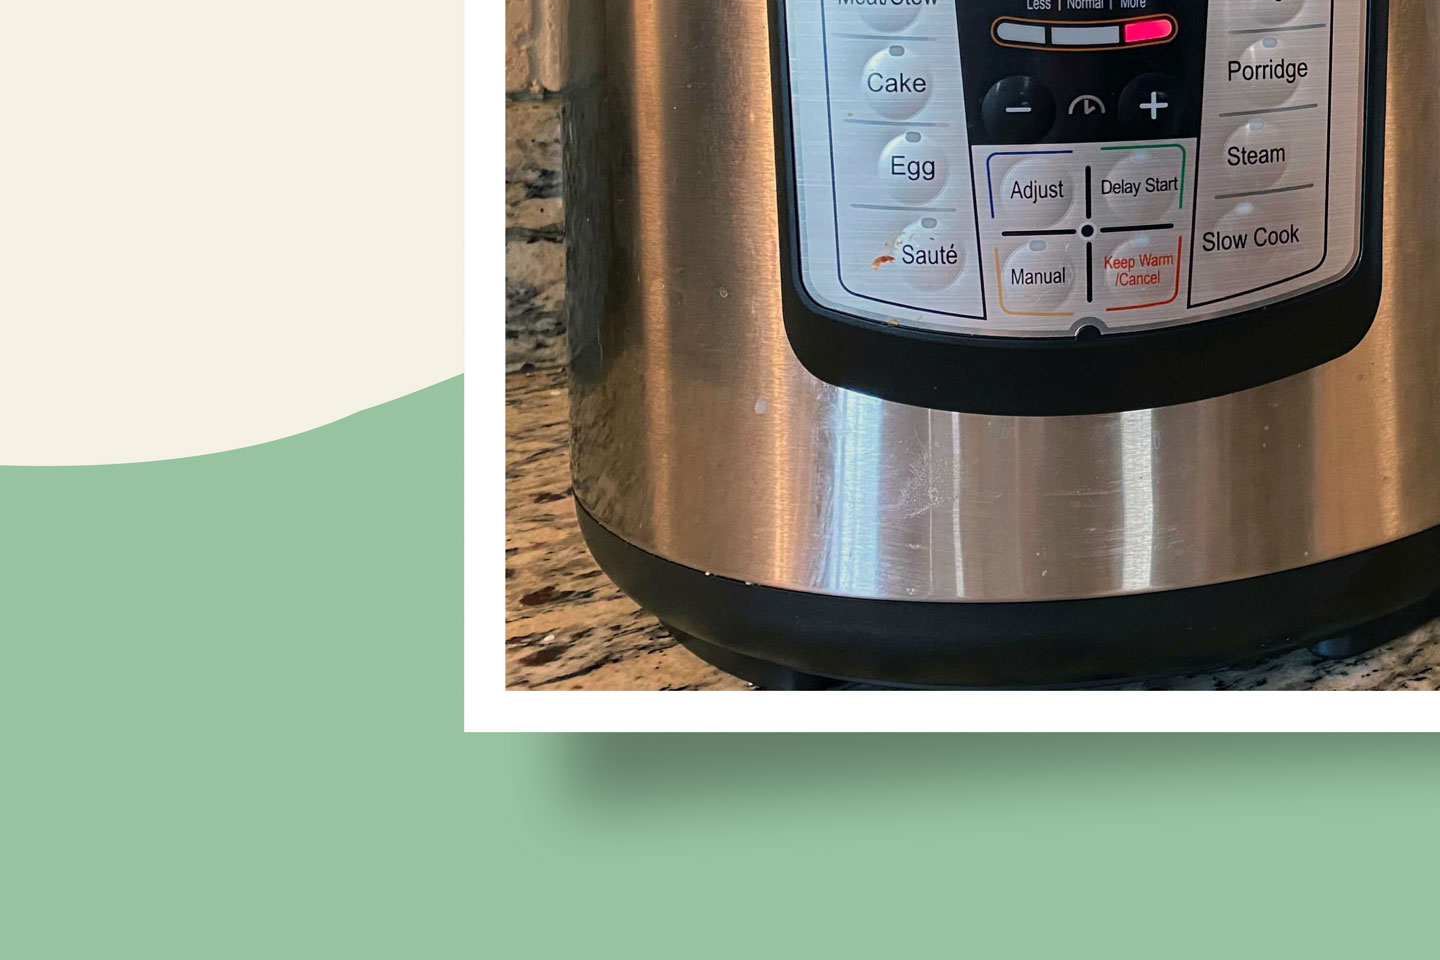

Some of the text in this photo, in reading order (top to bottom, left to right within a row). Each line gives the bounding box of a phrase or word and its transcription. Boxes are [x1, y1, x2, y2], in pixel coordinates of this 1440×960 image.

[1227, 59, 1308, 84] Porridge
[867, 72, 926, 94] Cake
[1226, 146, 1286, 166] Steam
[890, 155, 936, 180] Egg
[1010, 180, 1064, 203] Adjust
[1101, 177, 1178, 198] Delay Start
[1202, 225, 1300, 253] Slow Cook
[902, 243, 958, 266] Sauté
[1103, 253, 1174, 273] Keep Warm
[1011, 267, 1066, 286] Manual
